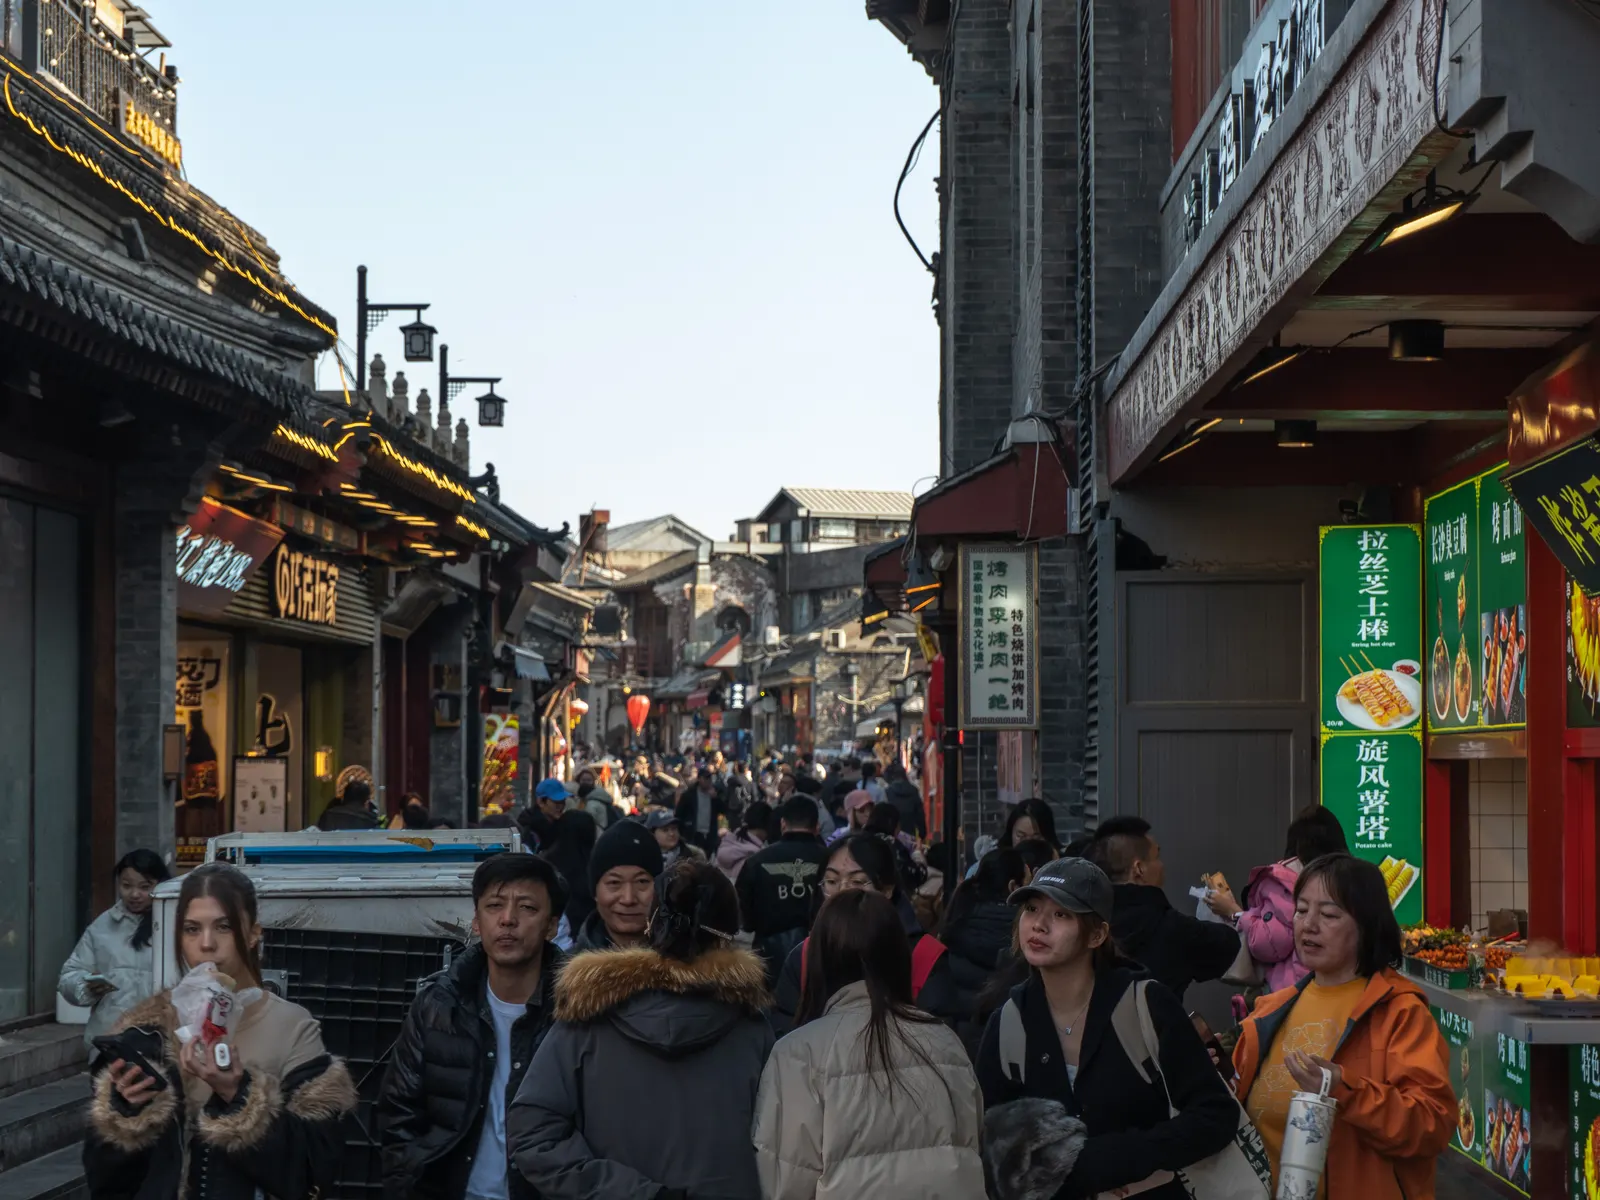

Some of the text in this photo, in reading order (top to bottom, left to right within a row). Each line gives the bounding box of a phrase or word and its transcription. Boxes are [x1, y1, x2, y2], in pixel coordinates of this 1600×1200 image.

[973, 560, 984, 674] 国家级非物质文化遗产
[1357, 530, 1389, 641] 拉丝芝士棒
[1010, 608, 1025, 711] 特色烧饼加烤肉
[1355, 738, 1390, 841] 旋风薯塔
[1377, 841, 1393, 849] cake
